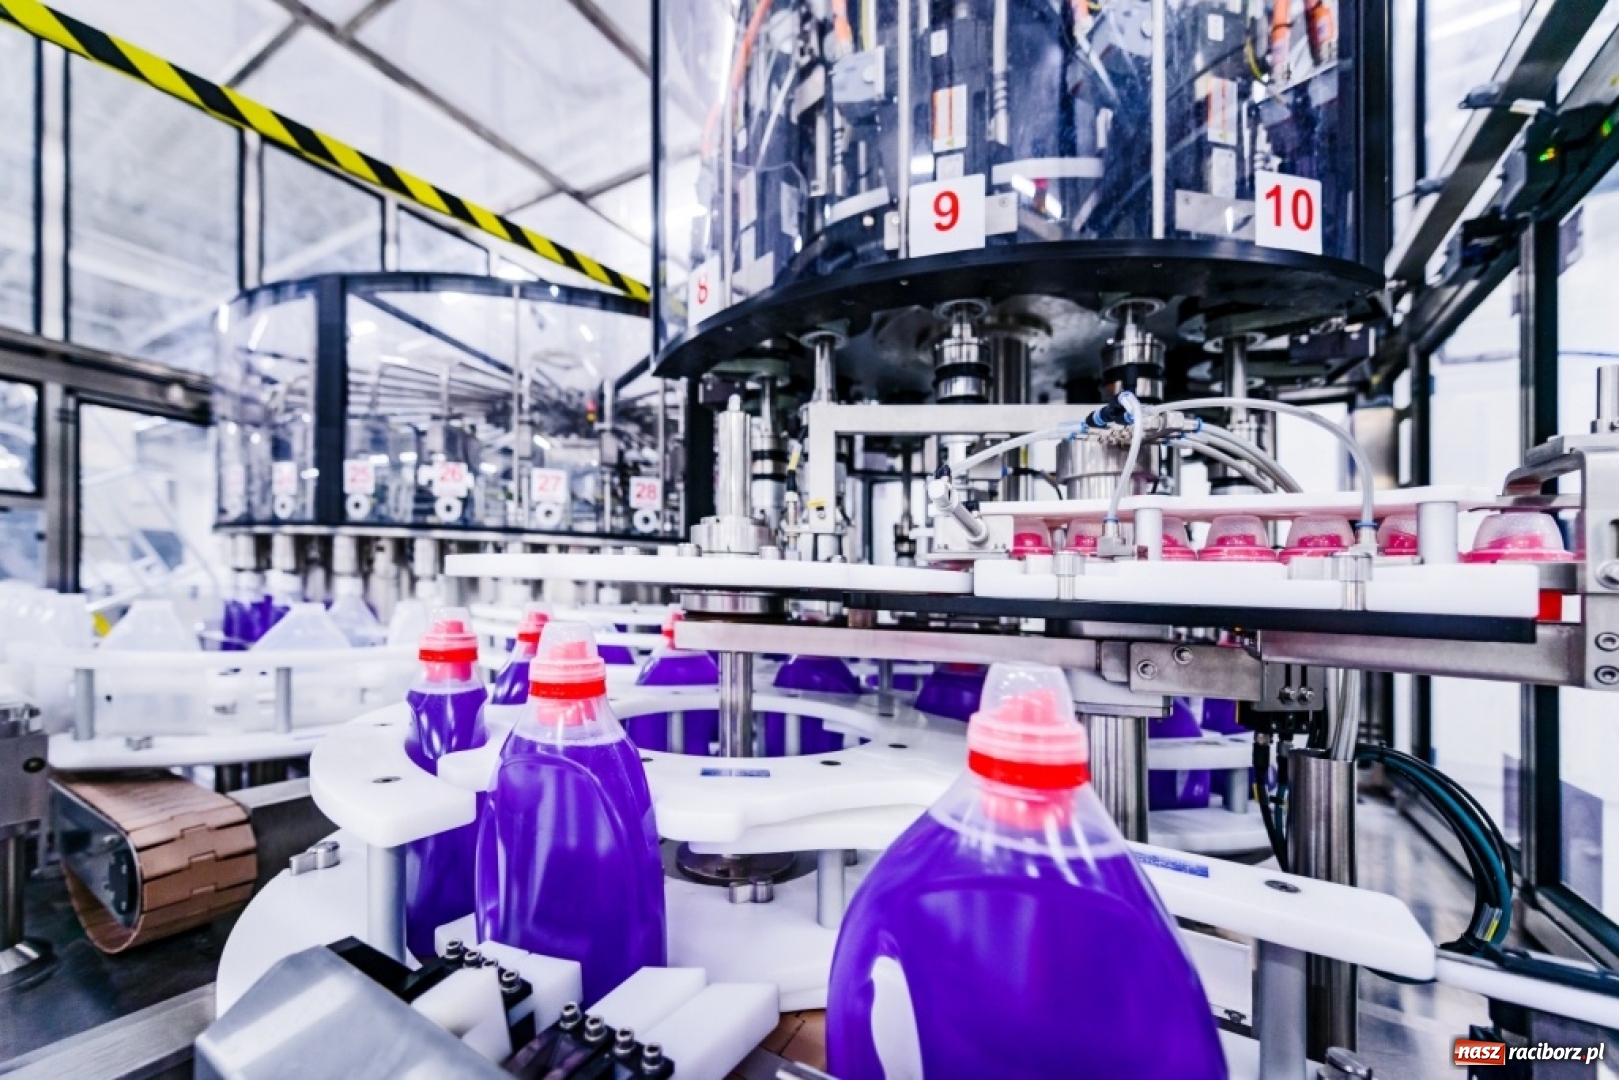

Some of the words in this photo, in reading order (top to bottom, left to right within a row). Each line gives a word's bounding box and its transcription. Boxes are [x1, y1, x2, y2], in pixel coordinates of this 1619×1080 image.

[933, 190, 960, 232] 9
[1265, 184, 1315, 232] 10
[696, 273, 709, 305] 8
[438, 462, 464, 482] 26
[537, 473, 562, 492] 27
[635, 482, 658, 501] 28
